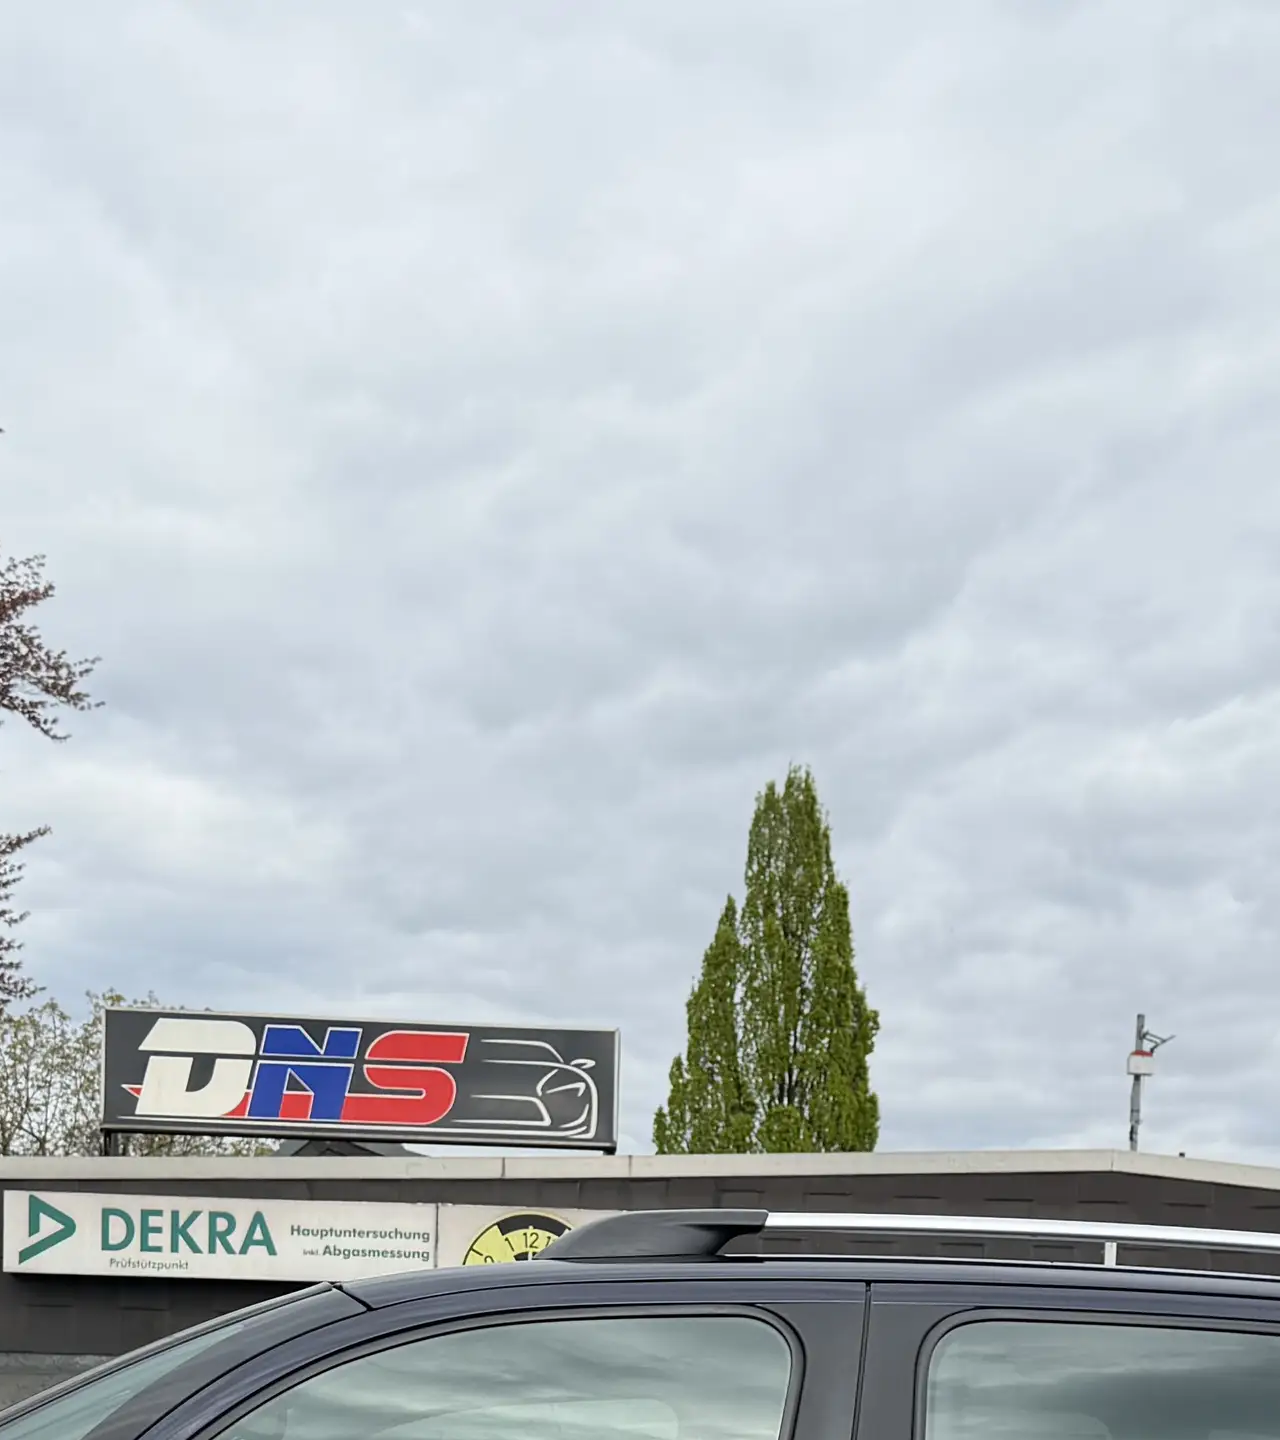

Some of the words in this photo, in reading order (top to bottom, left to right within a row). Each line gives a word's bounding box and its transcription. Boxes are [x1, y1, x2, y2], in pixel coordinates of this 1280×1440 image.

[134, 1017, 470, 1126] DNS
[101, 1207, 278, 1256] DEKRA
[290, 1224, 431, 1243] Hauptuntersuchung
[523, 1231, 540, 1249] 12
[322, 1244, 431, 1262] Abgasmessung
[109, 1257, 189, 1271] Prüfstützpunkt
